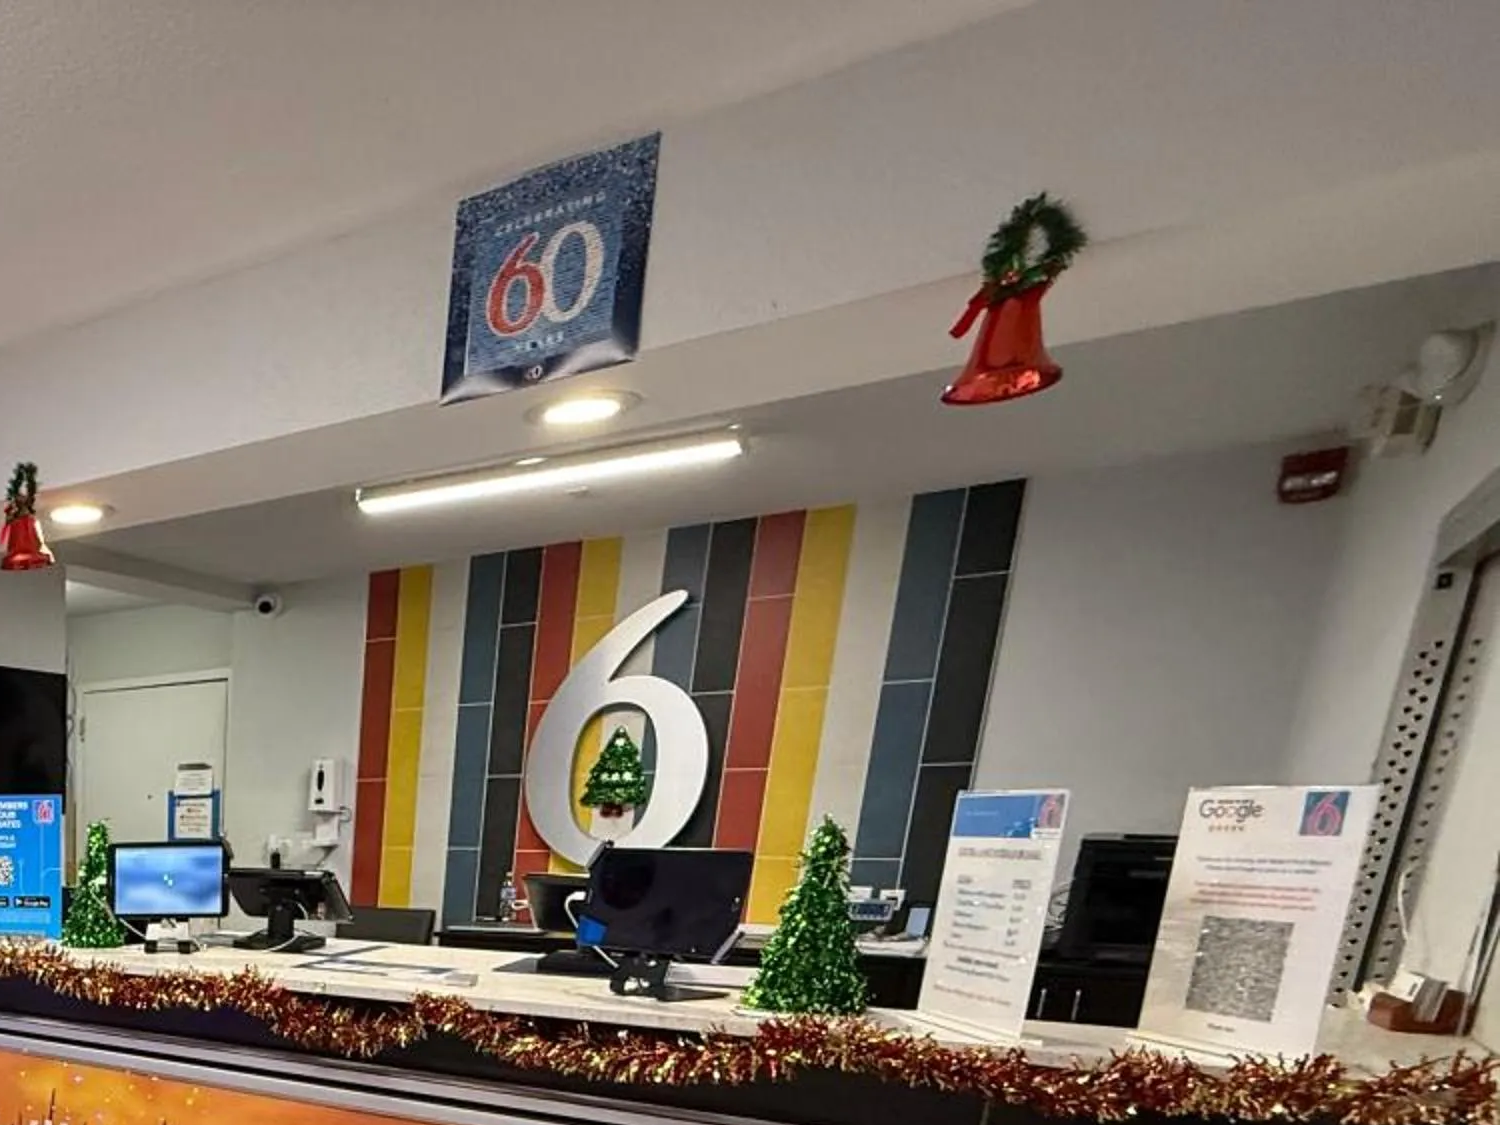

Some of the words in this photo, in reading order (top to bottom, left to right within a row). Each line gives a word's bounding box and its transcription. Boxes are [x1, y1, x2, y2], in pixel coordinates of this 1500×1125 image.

[485, 220, 605, 337] 60
[525, 589, 709, 869] 6
[1199, 799, 1264, 823] Google
[1307, 791, 1342, 836] 6
